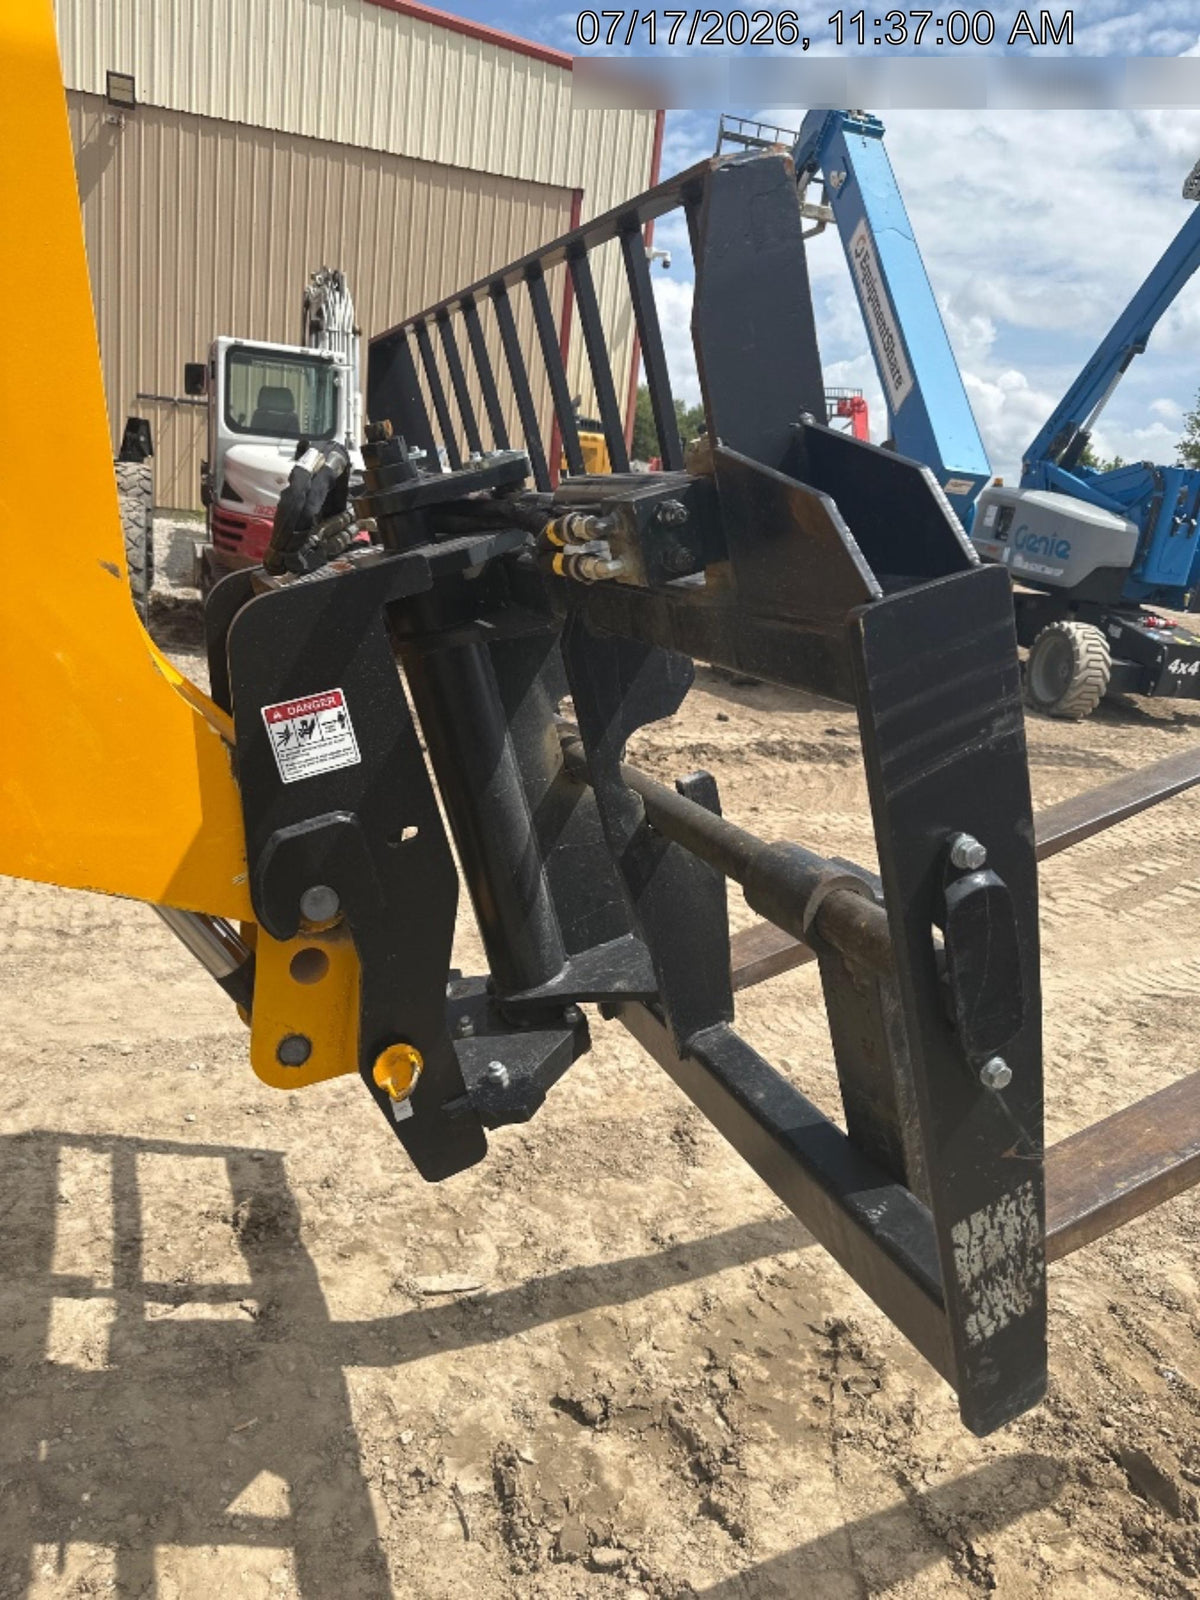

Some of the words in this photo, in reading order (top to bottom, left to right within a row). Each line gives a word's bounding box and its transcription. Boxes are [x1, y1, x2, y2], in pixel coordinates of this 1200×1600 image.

[860, 250, 903, 390] EquipmentShare
[1014, 525, 1071, 560] Genie
[1168, 659, 1200, 676] 4x4
[287, 697, 336, 715] DANGER
